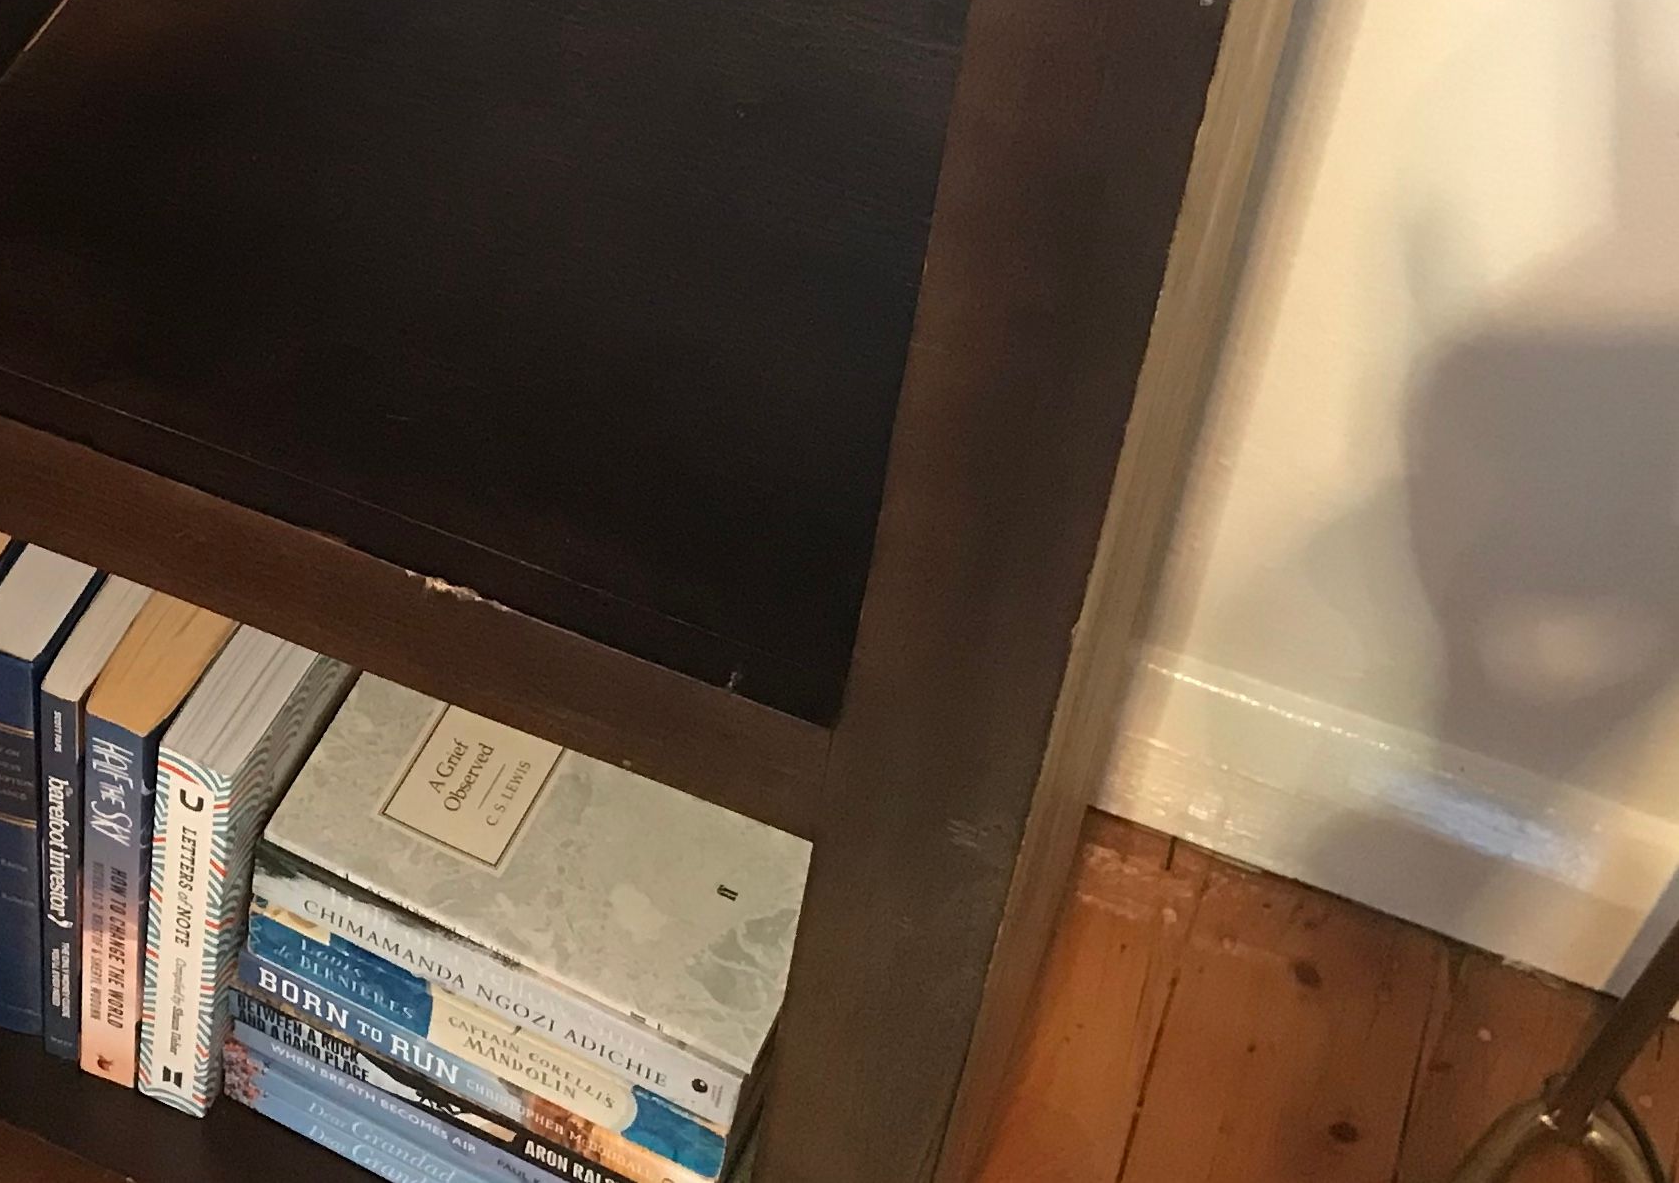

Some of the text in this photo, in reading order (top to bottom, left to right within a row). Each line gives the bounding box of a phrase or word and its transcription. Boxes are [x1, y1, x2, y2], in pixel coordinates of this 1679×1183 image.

[90, 737, 134, 847] HALF THE SKY
[428, 738, 470, 794] A Grief
[443, 742, 495, 812] Observed
[501, 760, 531, 801] LEWIS
[48, 774, 70, 918] barefoot investor
[175, 825, 197, 948] LETTERS of NOTE
[107, 866, 128, 1029] HOW TO CHANGE THE WORLD
[237, 994, 303, 1036] BETWEEN
[307, 1026, 318, 1042] A
[258, 966, 461, 1085] BORN TO RUN
[303, 899, 466, 989] CHIMAMANDA
[475, 984, 556, 1033] NGOZI
[563, 1028, 668, 1089] ADICHIE
[239, 1010, 371, 1082] AND A HARD PLACE
[448, 1016, 617, 1110] CAPTAIN CORELLI'S
[462, 1035, 577, 1101] MANDOLIN
[271, 1042, 477, 1155] WHEN BREATH BECOMES AIR
[466, 1078, 565, 1135] CHRISTOPHER
[351, 1119, 456, 1183] Grandad
[524, 1139, 569, 1173] ARON
